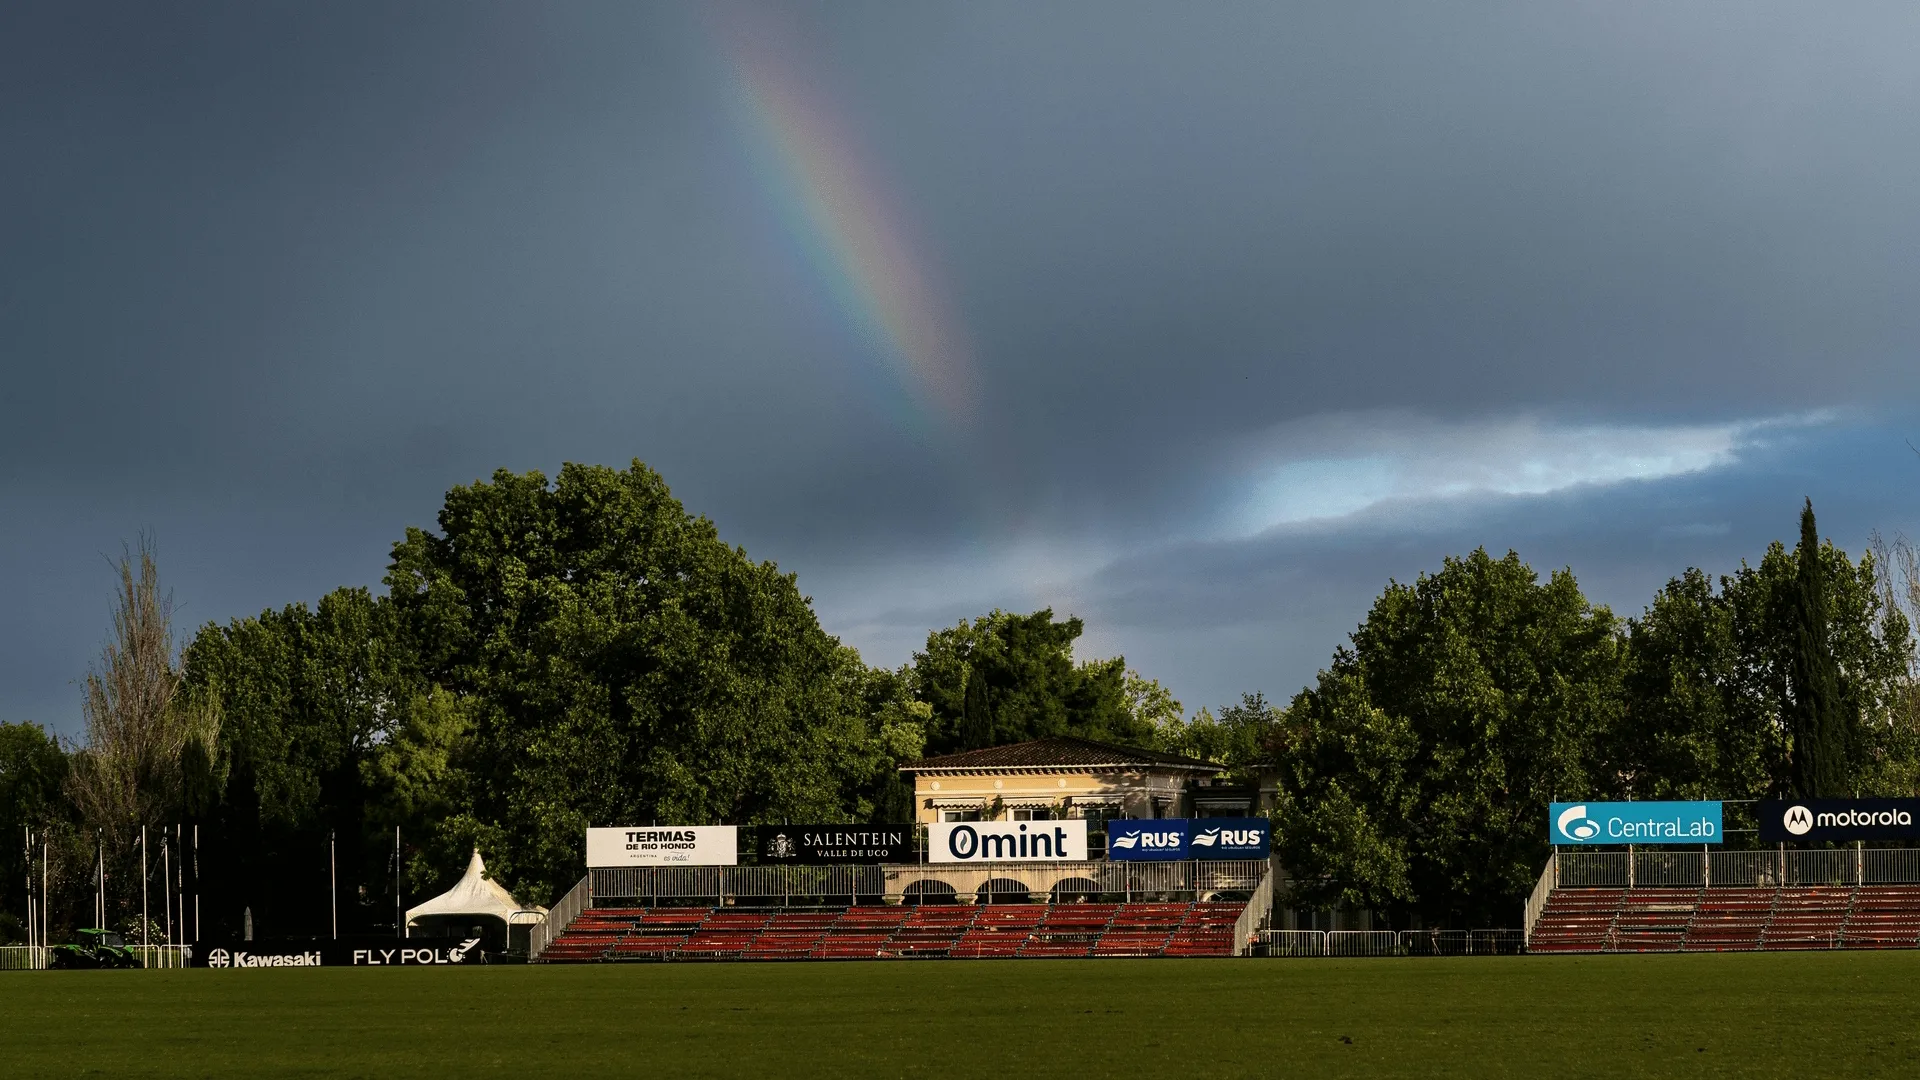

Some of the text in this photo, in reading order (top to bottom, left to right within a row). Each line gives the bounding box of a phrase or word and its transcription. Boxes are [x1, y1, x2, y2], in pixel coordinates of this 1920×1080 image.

[1817, 808, 1912, 827] motorola
[1608, 816, 1715, 838] CentraLab
[625, 831, 696, 843] TERMAS
[803, 832, 902, 846] SALENTEIN
[949, 823, 1068, 860] Omint
[625, 843, 639, 851] DE
[660, 842, 696, 850] HONDO
[817, 849, 889, 857] VALLE DE UCO
[233, 951, 321, 968] Kawasaki
[353, 949, 396, 965] FLY
